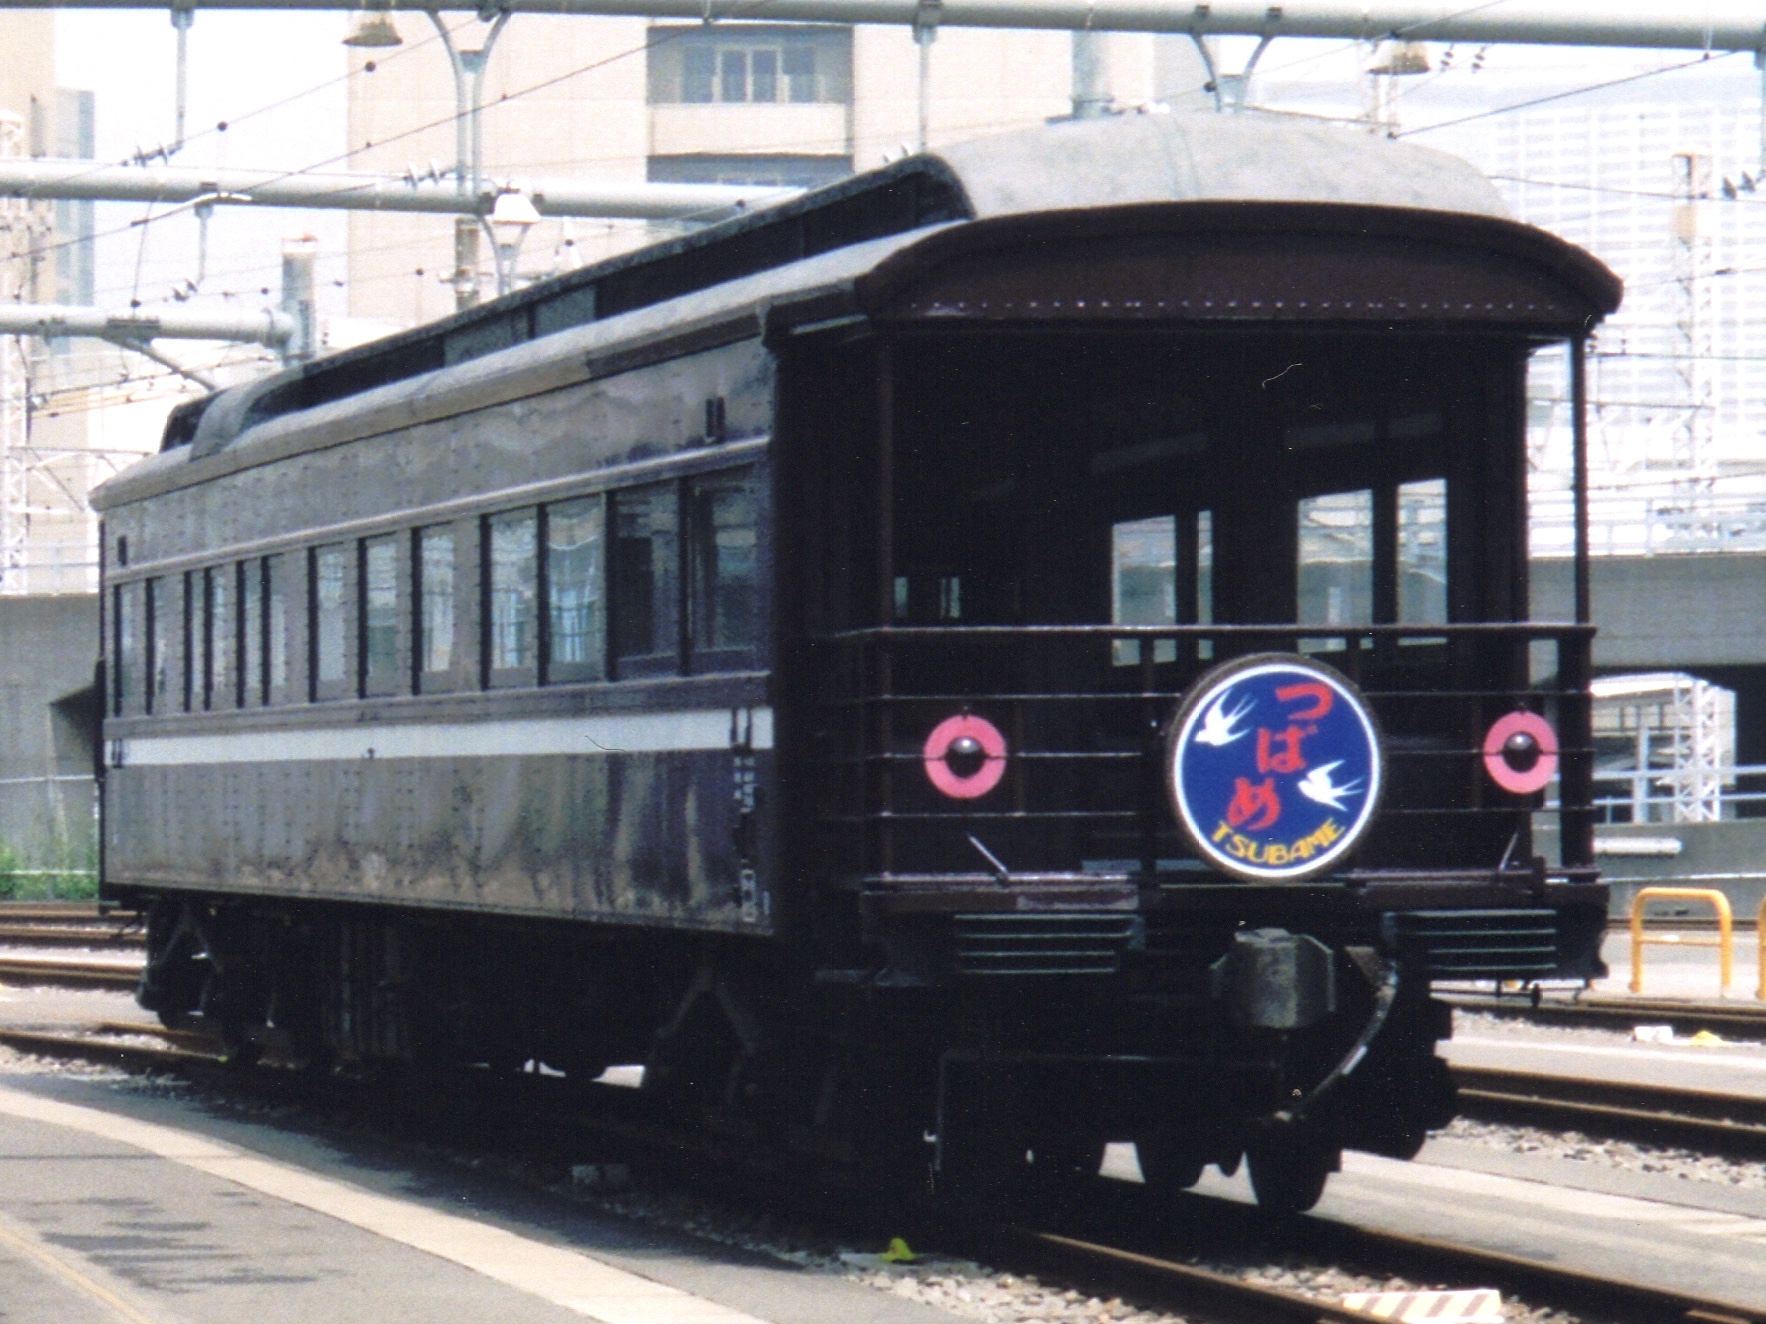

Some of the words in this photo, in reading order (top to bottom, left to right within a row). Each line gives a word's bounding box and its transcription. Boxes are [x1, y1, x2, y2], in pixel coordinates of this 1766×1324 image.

[1227, 683, 1334, 830] つばめ
[1211, 817, 1346, 865] TSUBAME
